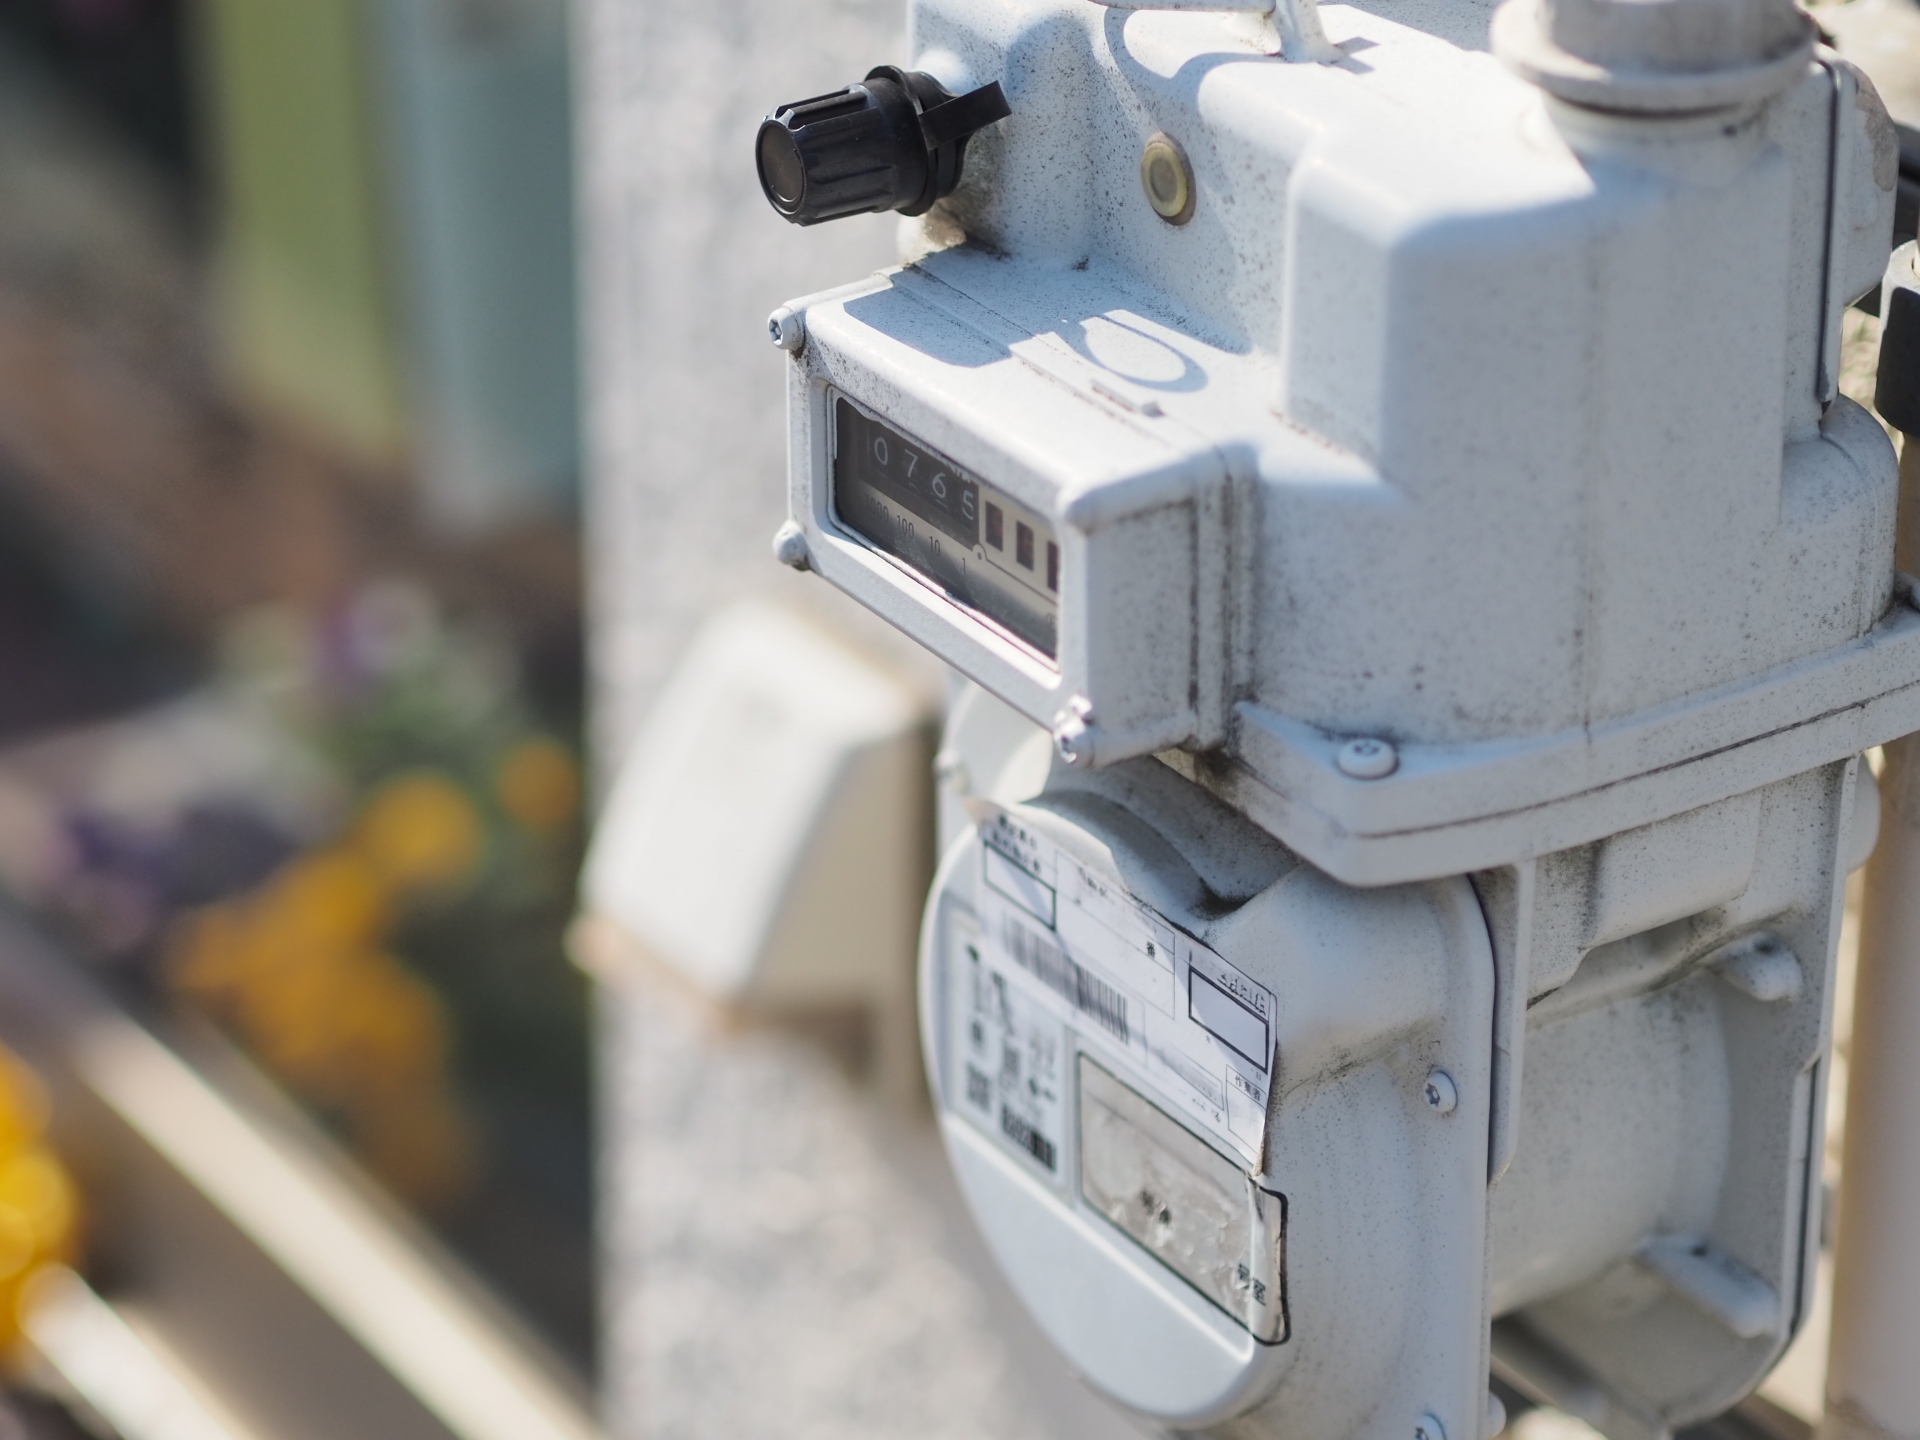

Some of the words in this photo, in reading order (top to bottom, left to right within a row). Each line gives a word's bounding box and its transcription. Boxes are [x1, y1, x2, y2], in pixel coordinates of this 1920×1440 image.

[865, 494, 889, 523] 1000
[896, 514, 915, 539] 100
[928, 535, 941, 557] 10
